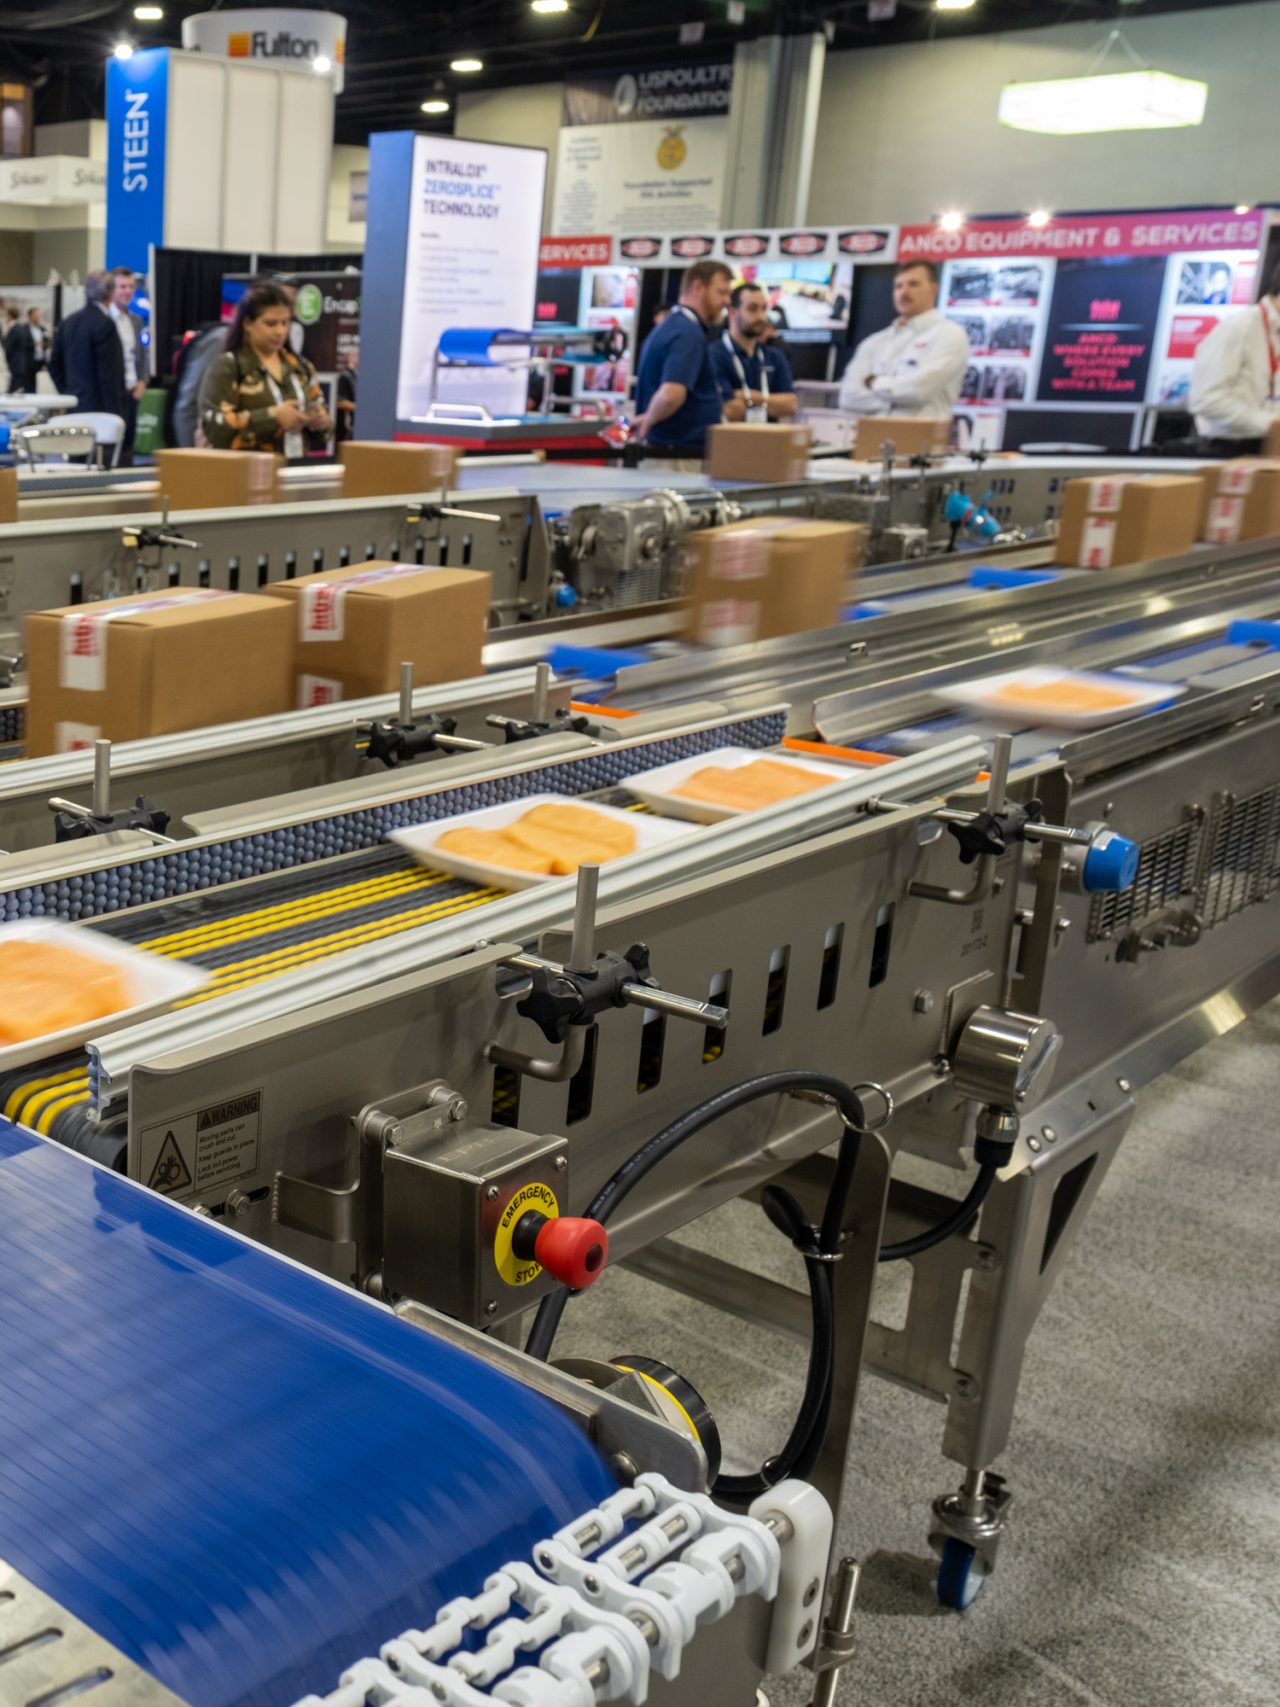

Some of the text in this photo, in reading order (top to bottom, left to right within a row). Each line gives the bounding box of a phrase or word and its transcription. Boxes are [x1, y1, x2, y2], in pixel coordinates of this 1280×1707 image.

[250, 31, 319, 58] Fulton
[637, 64, 733, 89] USPOULTR
[637, 90, 730, 114] FOUNDATIO
[122, 91, 149, 192] STEEN
[900, 233, 961, 253] ANCO
[966, 226, 1099, 251] EQUIPMENT
[1131, 220, 1258, 246] SERVICES
[539, 242, 610, 263] ERVICES
[323, 295, 360, 315] Encap
[212, 1096, 258, 1121] WARNING
[501, 1185, 556, 1229] EMERGENCY
